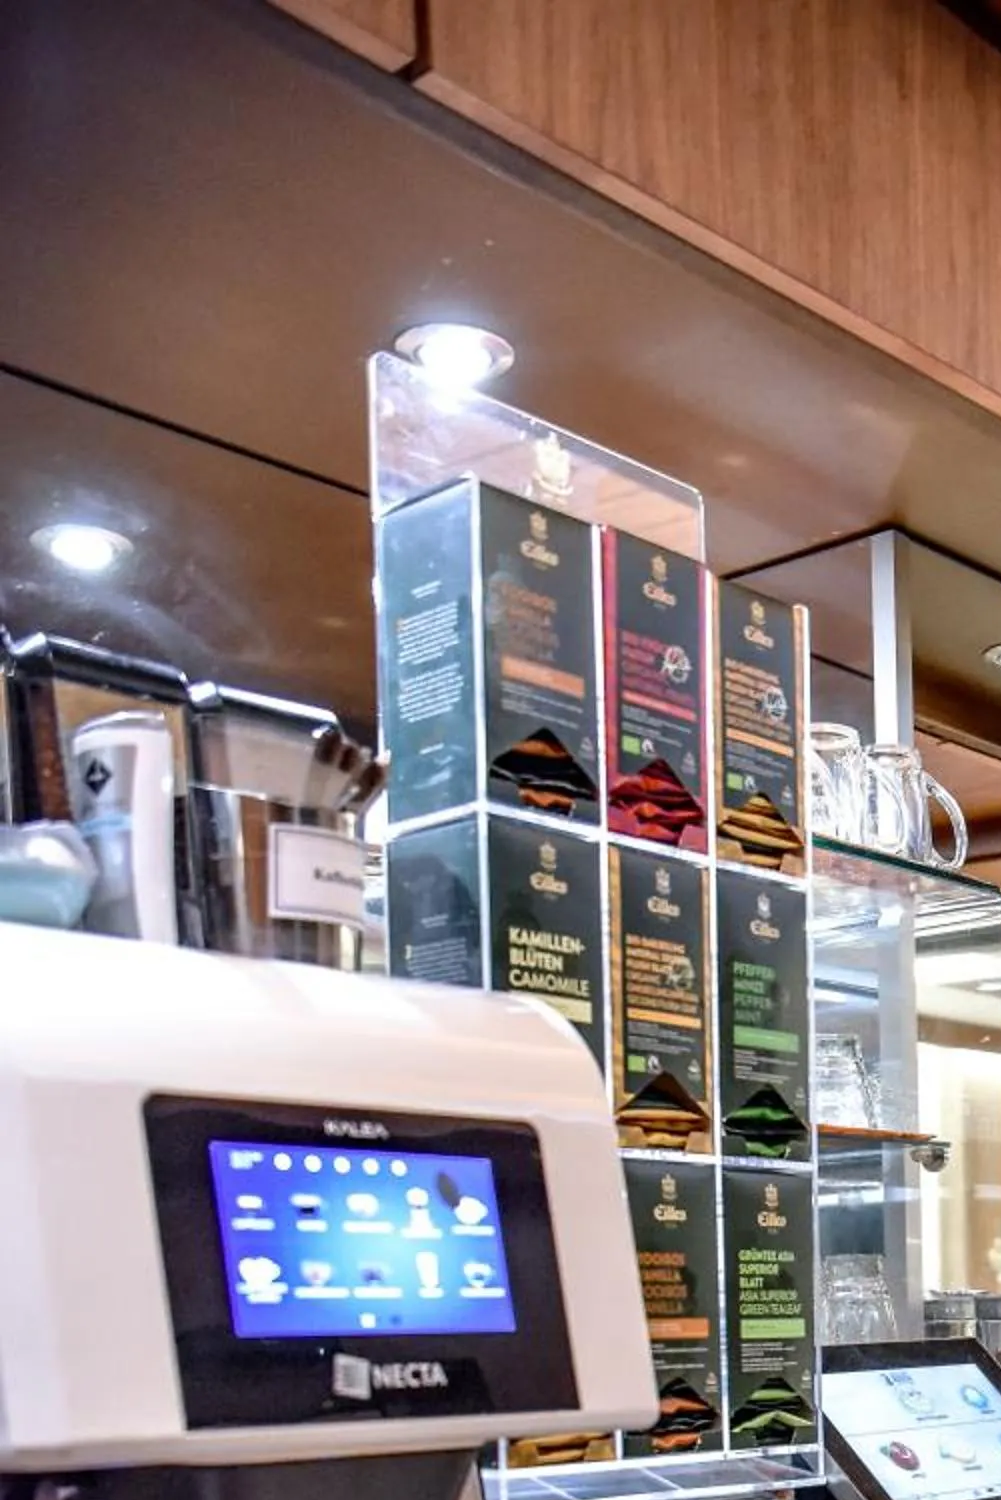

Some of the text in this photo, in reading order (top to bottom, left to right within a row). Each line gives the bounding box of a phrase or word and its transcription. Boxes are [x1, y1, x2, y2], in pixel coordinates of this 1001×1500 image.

[509, 925, 586, 956] KAMILLEN-
[509, 969, 591, 997] CAMOMILE
[371, 1362, 449, 1390] NECTA
